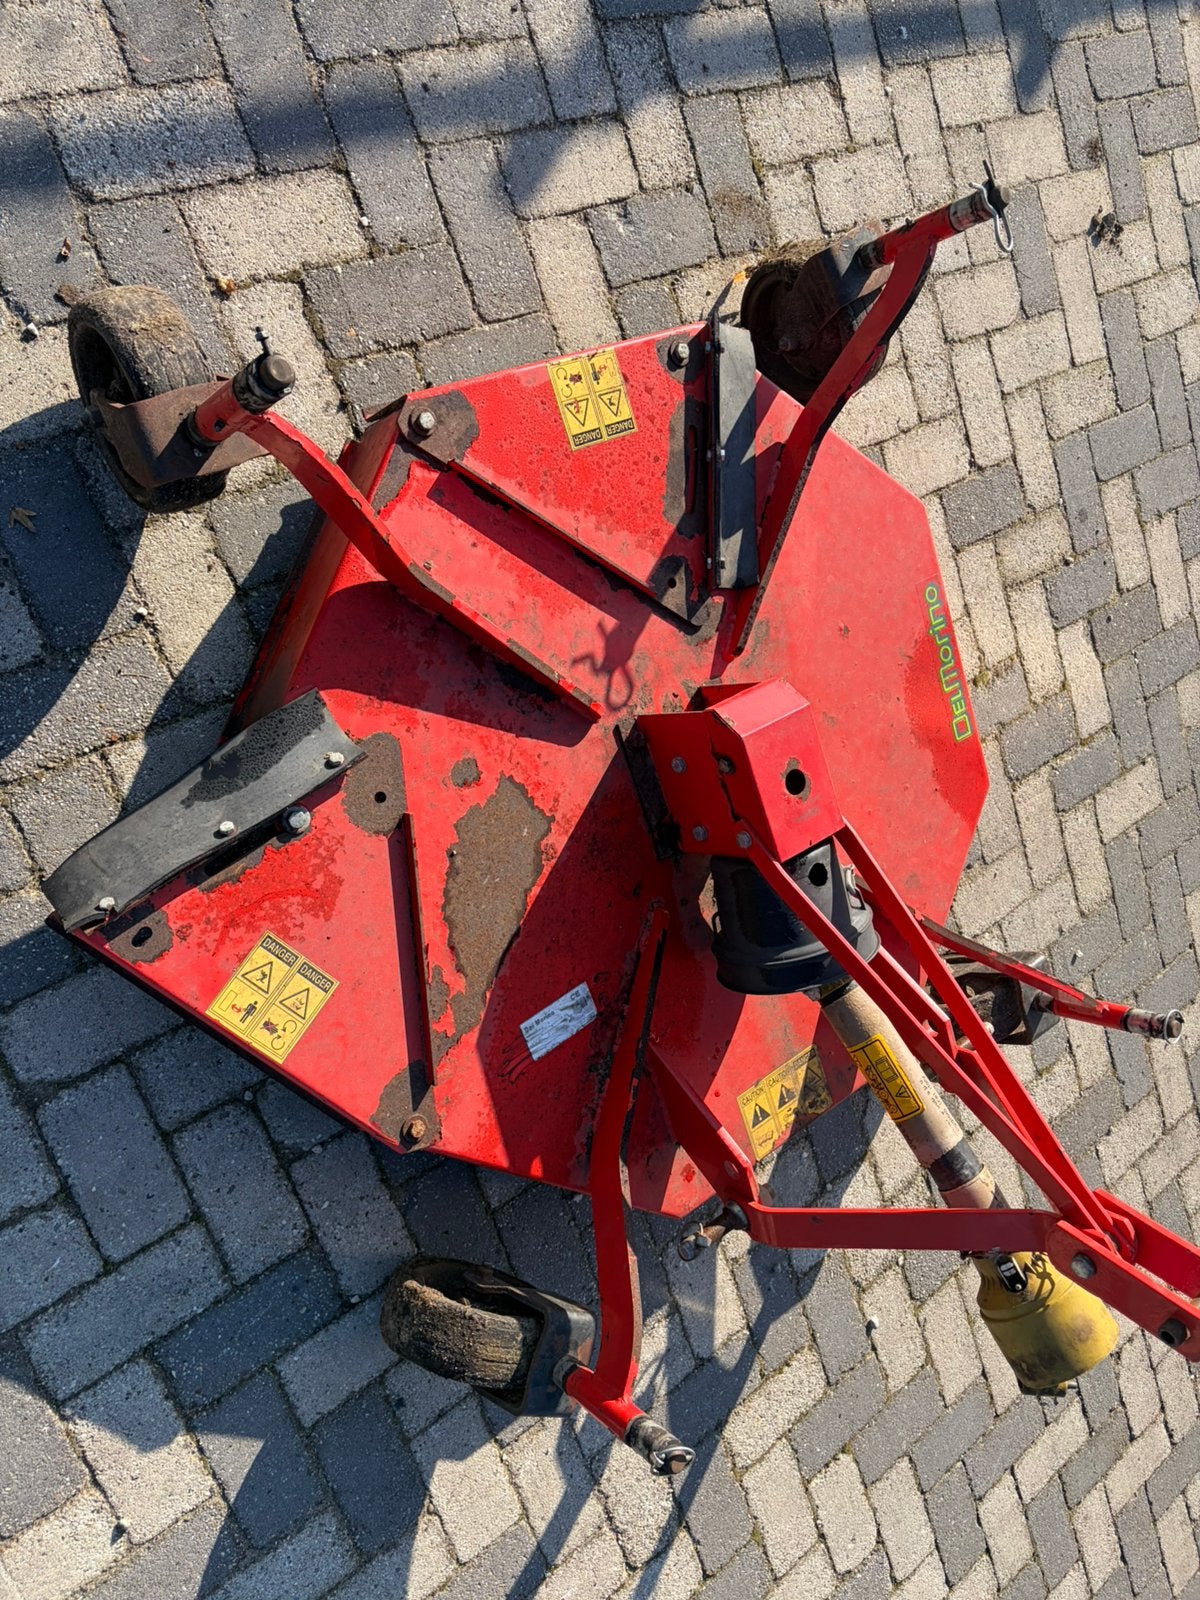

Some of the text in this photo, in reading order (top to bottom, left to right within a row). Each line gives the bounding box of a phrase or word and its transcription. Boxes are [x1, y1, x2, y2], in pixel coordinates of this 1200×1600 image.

[607, 419, 634, 435] DANGER
[574, 429, 601, 445] DANGER
[262, 937, 296, 965] DANGER
[300, 963, 332, 991] DANGER
[768, 1066, 792, 1087] CAUTI
[742, 1087, 765, 1105] CAUTION
